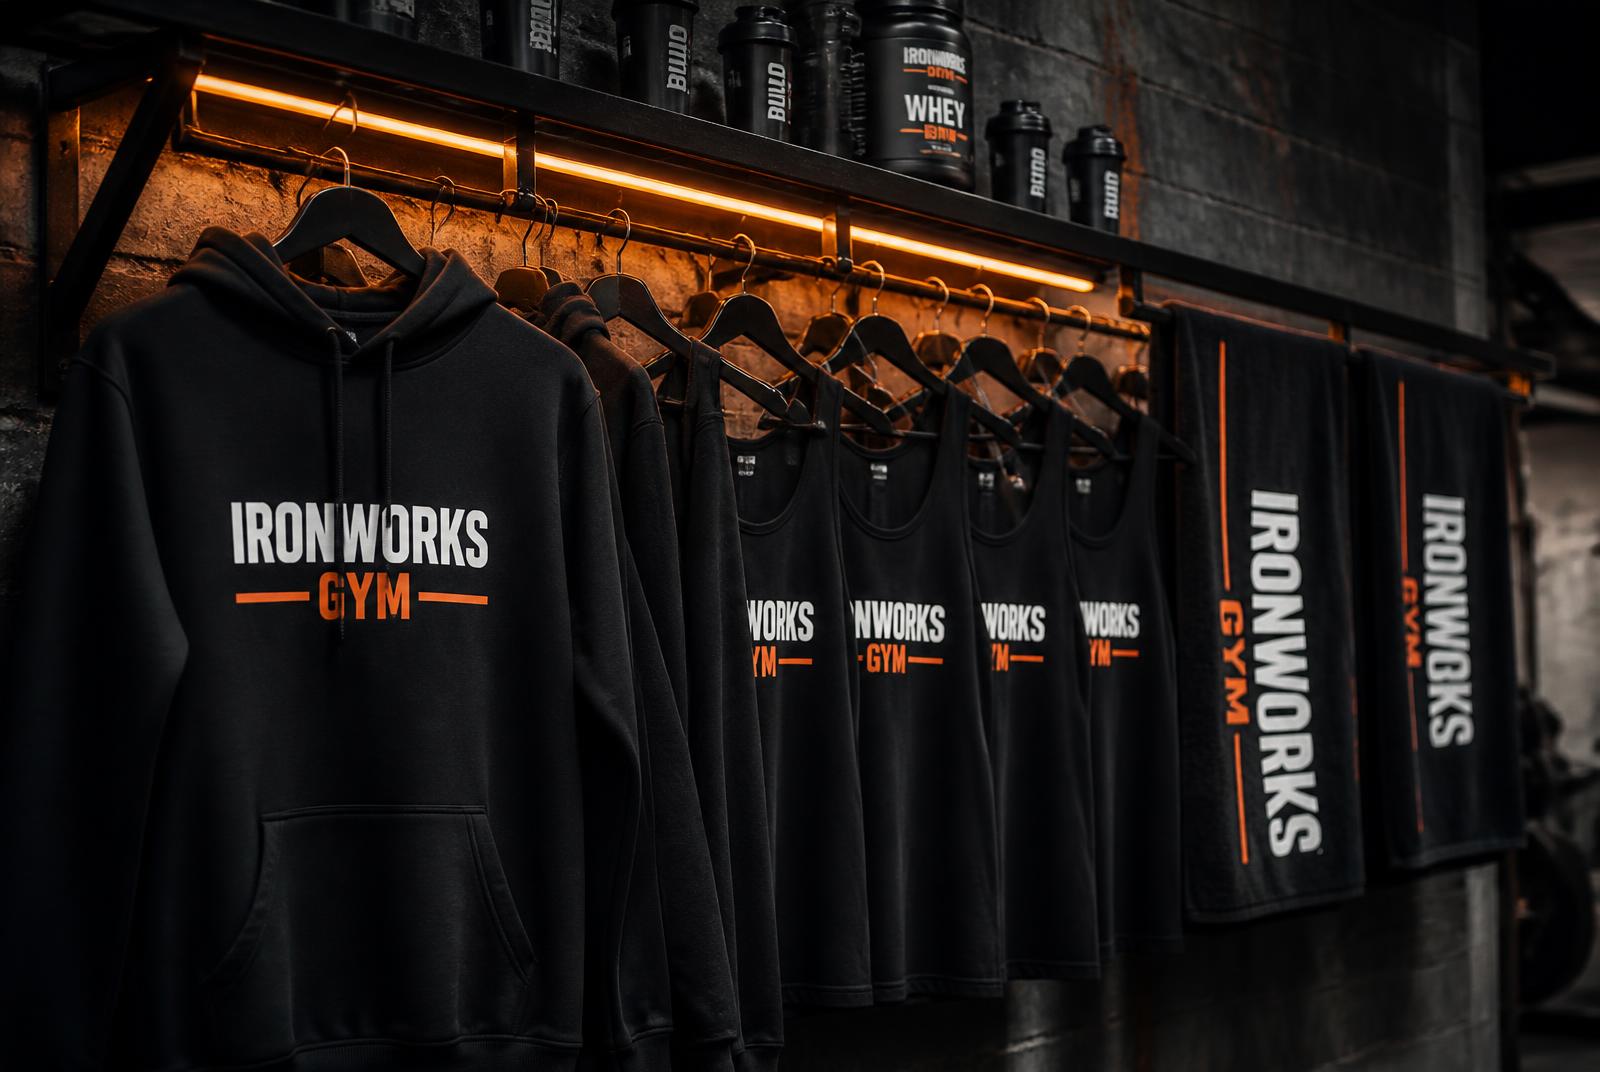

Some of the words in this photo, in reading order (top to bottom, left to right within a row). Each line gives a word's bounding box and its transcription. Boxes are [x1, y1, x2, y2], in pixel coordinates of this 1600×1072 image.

[904, 94, 965, 129] WHEY
[231, 501, 489, 568] IRONWORKS
[318, 571, 410, 620] GYM
[850, 600, 945, 643] NWORKS
[981, 603, 1046, 642] WORKS
[1080, 601, 1140, 638] WORKS
[1402, 576, 1422, 668] GYM
[866, 642, 906, 674] GYM
[1219, 599, 1250, 725] GYM
[1250, 489, 1323, 858] IRONWORKS
